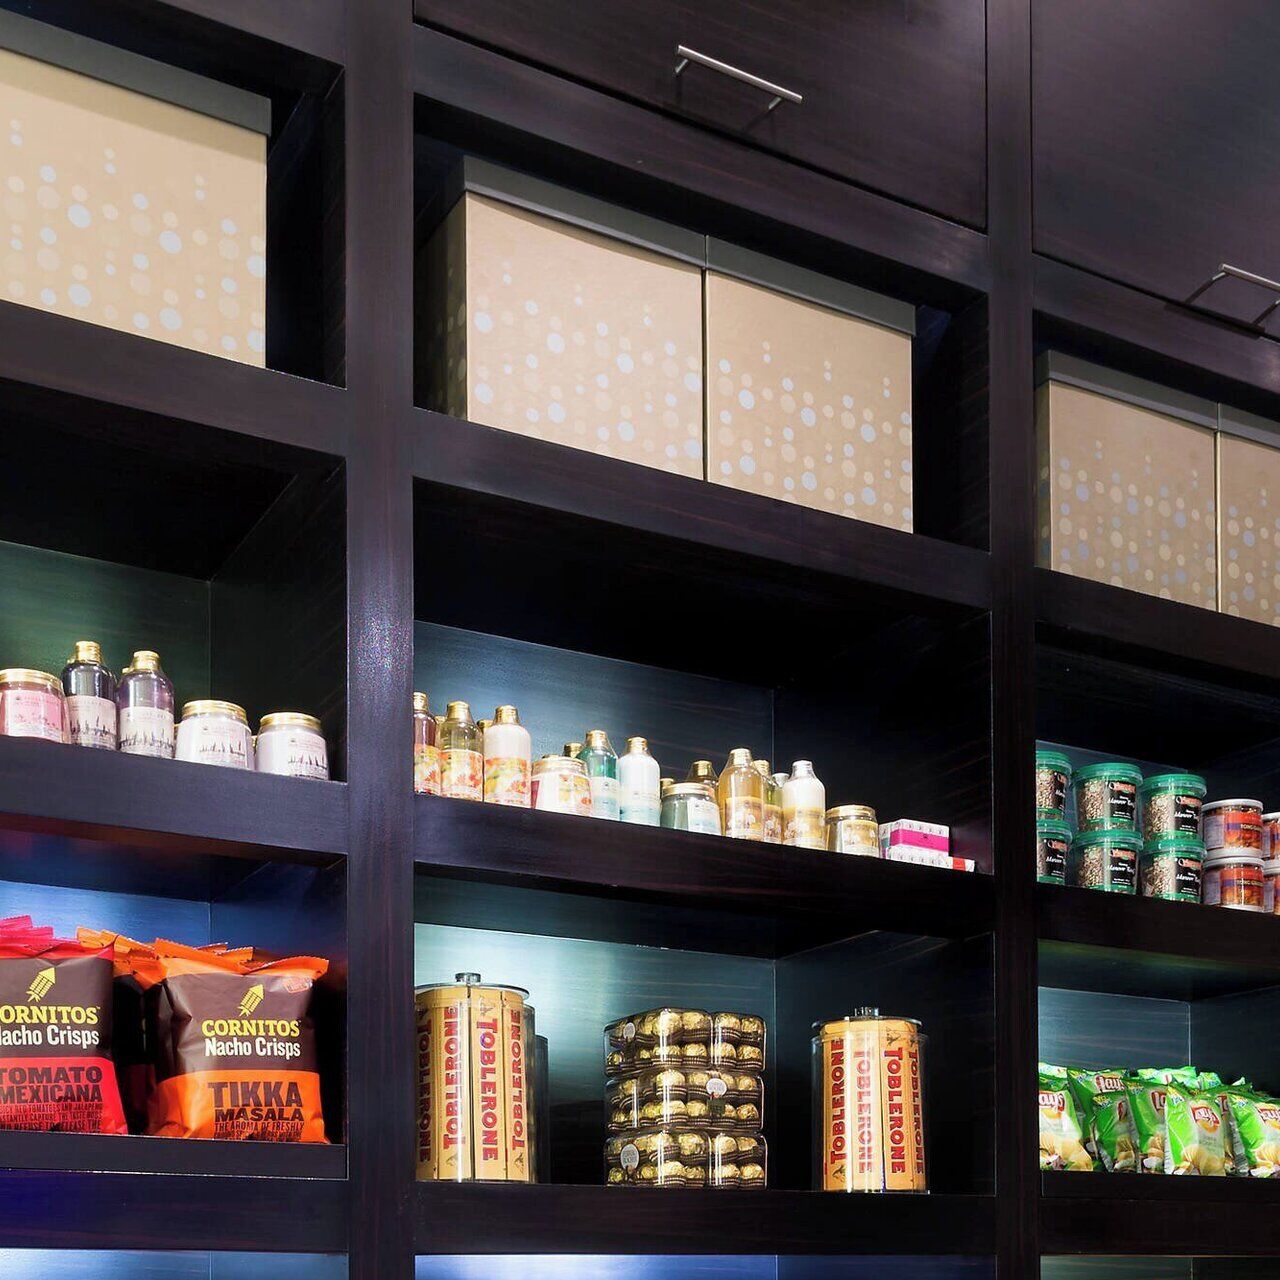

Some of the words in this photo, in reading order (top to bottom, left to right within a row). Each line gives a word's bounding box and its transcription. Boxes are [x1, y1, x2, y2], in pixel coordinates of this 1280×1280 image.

[46, 1025, 100, 1049] Crisps
[201, 1020, 300, 1038] CORNITOS
[205, 1037, 252, 1057] Nacho
[255, 1037, 301, 1060] Crisps
[417, 1018, 432, 1163] TOBLERONE
[443, 1006, 462, 1150] TOBLERONE
[477, 1017, 499, 1161] TOBLERONE
[510, 1009, 526, 1151] TOBLERONE
[207, 1081, 304, 1108] TIKKA
[214, 1107, 305, 1123] MASALA
[831, 1037, 847, 1164] TOBLERONE
[854, 1049, 873, 1174] TOBLERONE
[884, 1046, 906, 1174] TOBLERONE
[908, 1049, 925, 1175] TOBLERONE
